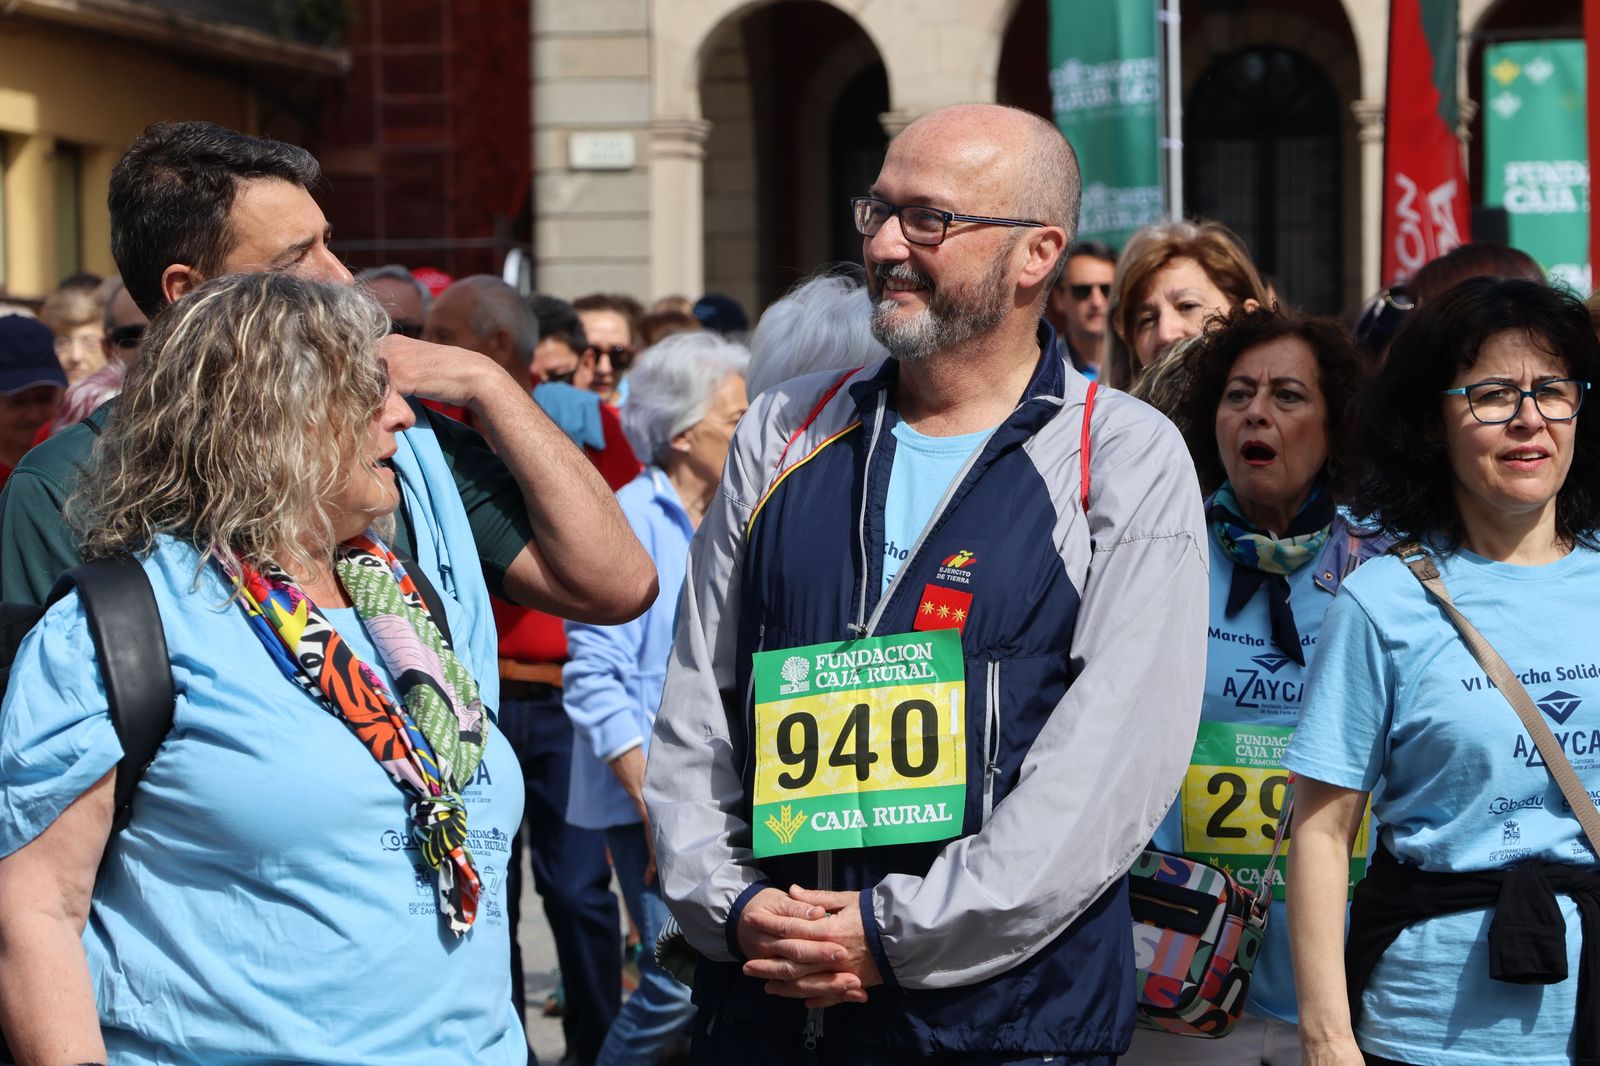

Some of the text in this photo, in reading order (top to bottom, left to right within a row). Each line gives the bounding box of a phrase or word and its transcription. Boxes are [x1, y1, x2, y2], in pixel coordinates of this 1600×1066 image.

[1504, 160, 1589, 187] FUND
[939, 566, 971, 577] EJERCITO
[946, 574, 970, 584] TIERRA
[1208, 626, 1265, 647] Marcha
[815, 642, 934, 671] FUNDACION
[815, 661, 935, 689] CAJA RURAL
[1461, 677, 1482, 692] VI
[776, 698, 940, 790] 940
[1236, 733, 1295, 747] FUNDAC
[1236, 745, 1268, 758] CAJA
[1488, 795, 1544, 815] Cobadu
[811, 803, 953, 832] CAJA RURAL
[466, 840, 509, 853] AJA RURAL
[1237, 868, 1286, 886] CAA
